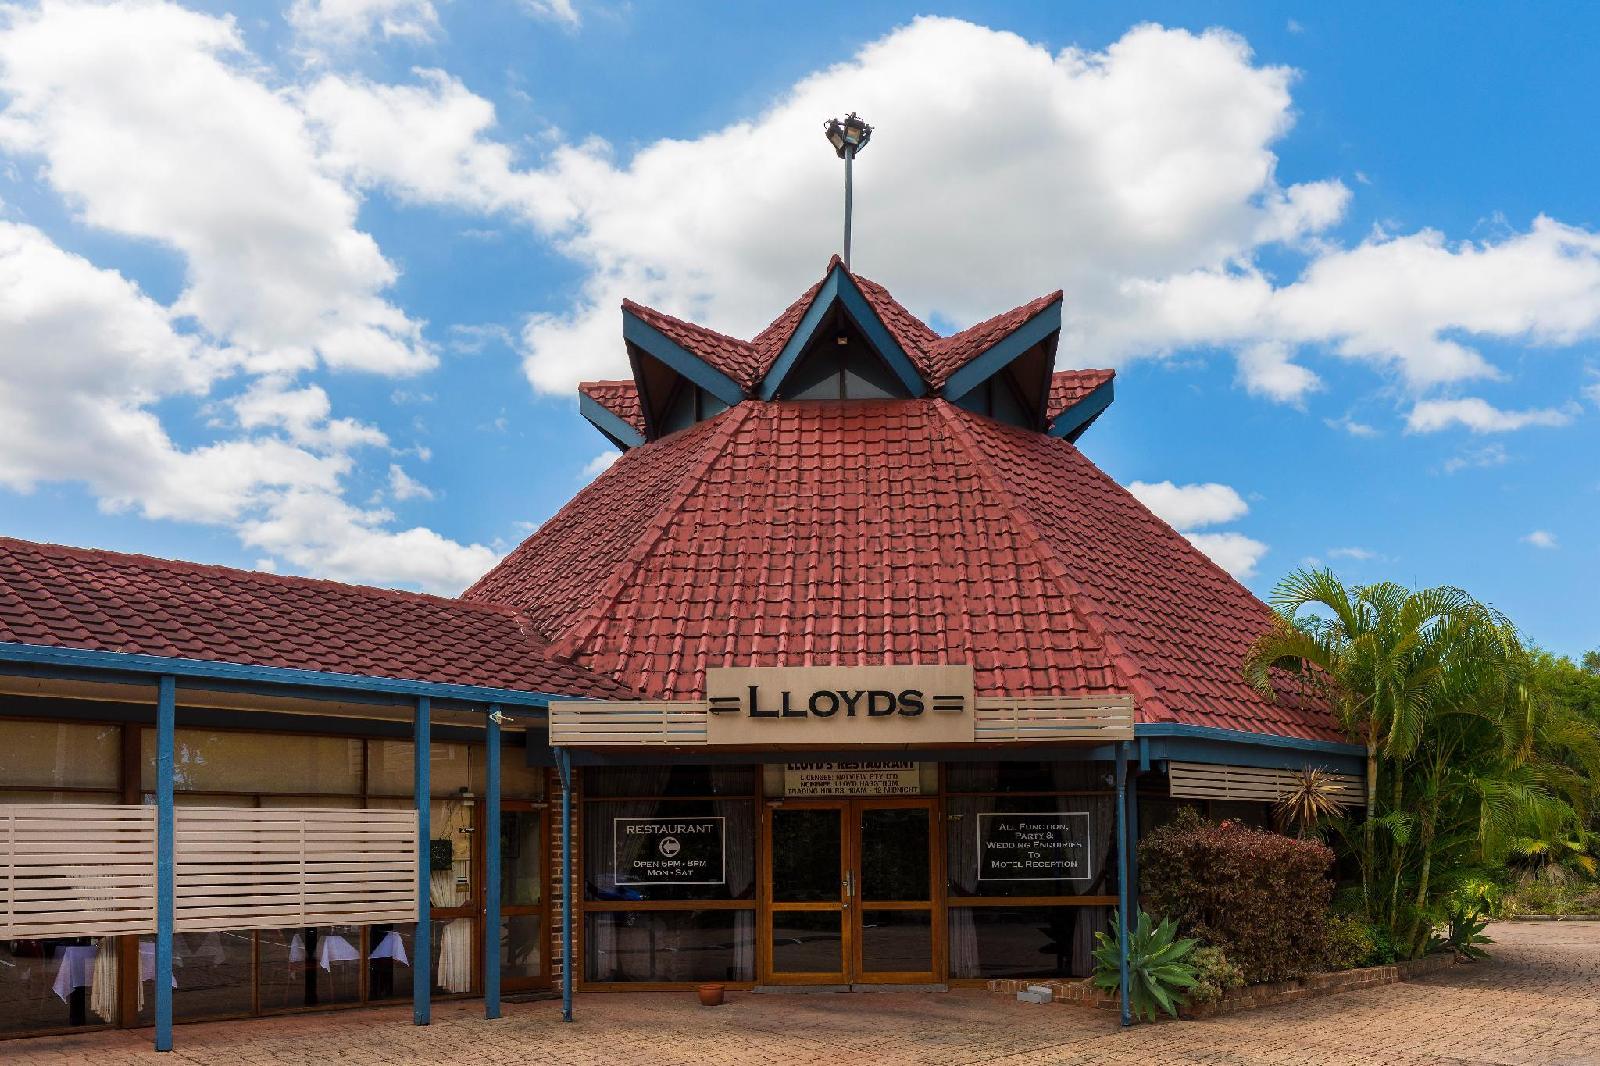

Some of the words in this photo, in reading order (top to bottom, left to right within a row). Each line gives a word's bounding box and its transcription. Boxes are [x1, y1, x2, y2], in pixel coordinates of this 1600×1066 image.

[748, 686, 925, 718] LLOYDS
[787, 761, 833, 770] LLOYDS
[626, 824, 714, 834] RESTAURANT
[1015, 832, 1045, 840] PARTY
[1046, 831, 1054, 840] &
[985, 841, 1031, 849] WEDDING
[1027, 851, 1041, 859] TO
[633, 860, 660, 868] OPEN
[991, 860, 1024, 869] MOTEL
[1025, 860, 1078, 868] RECEPTION
[675, 868, 694, 876] SAT
